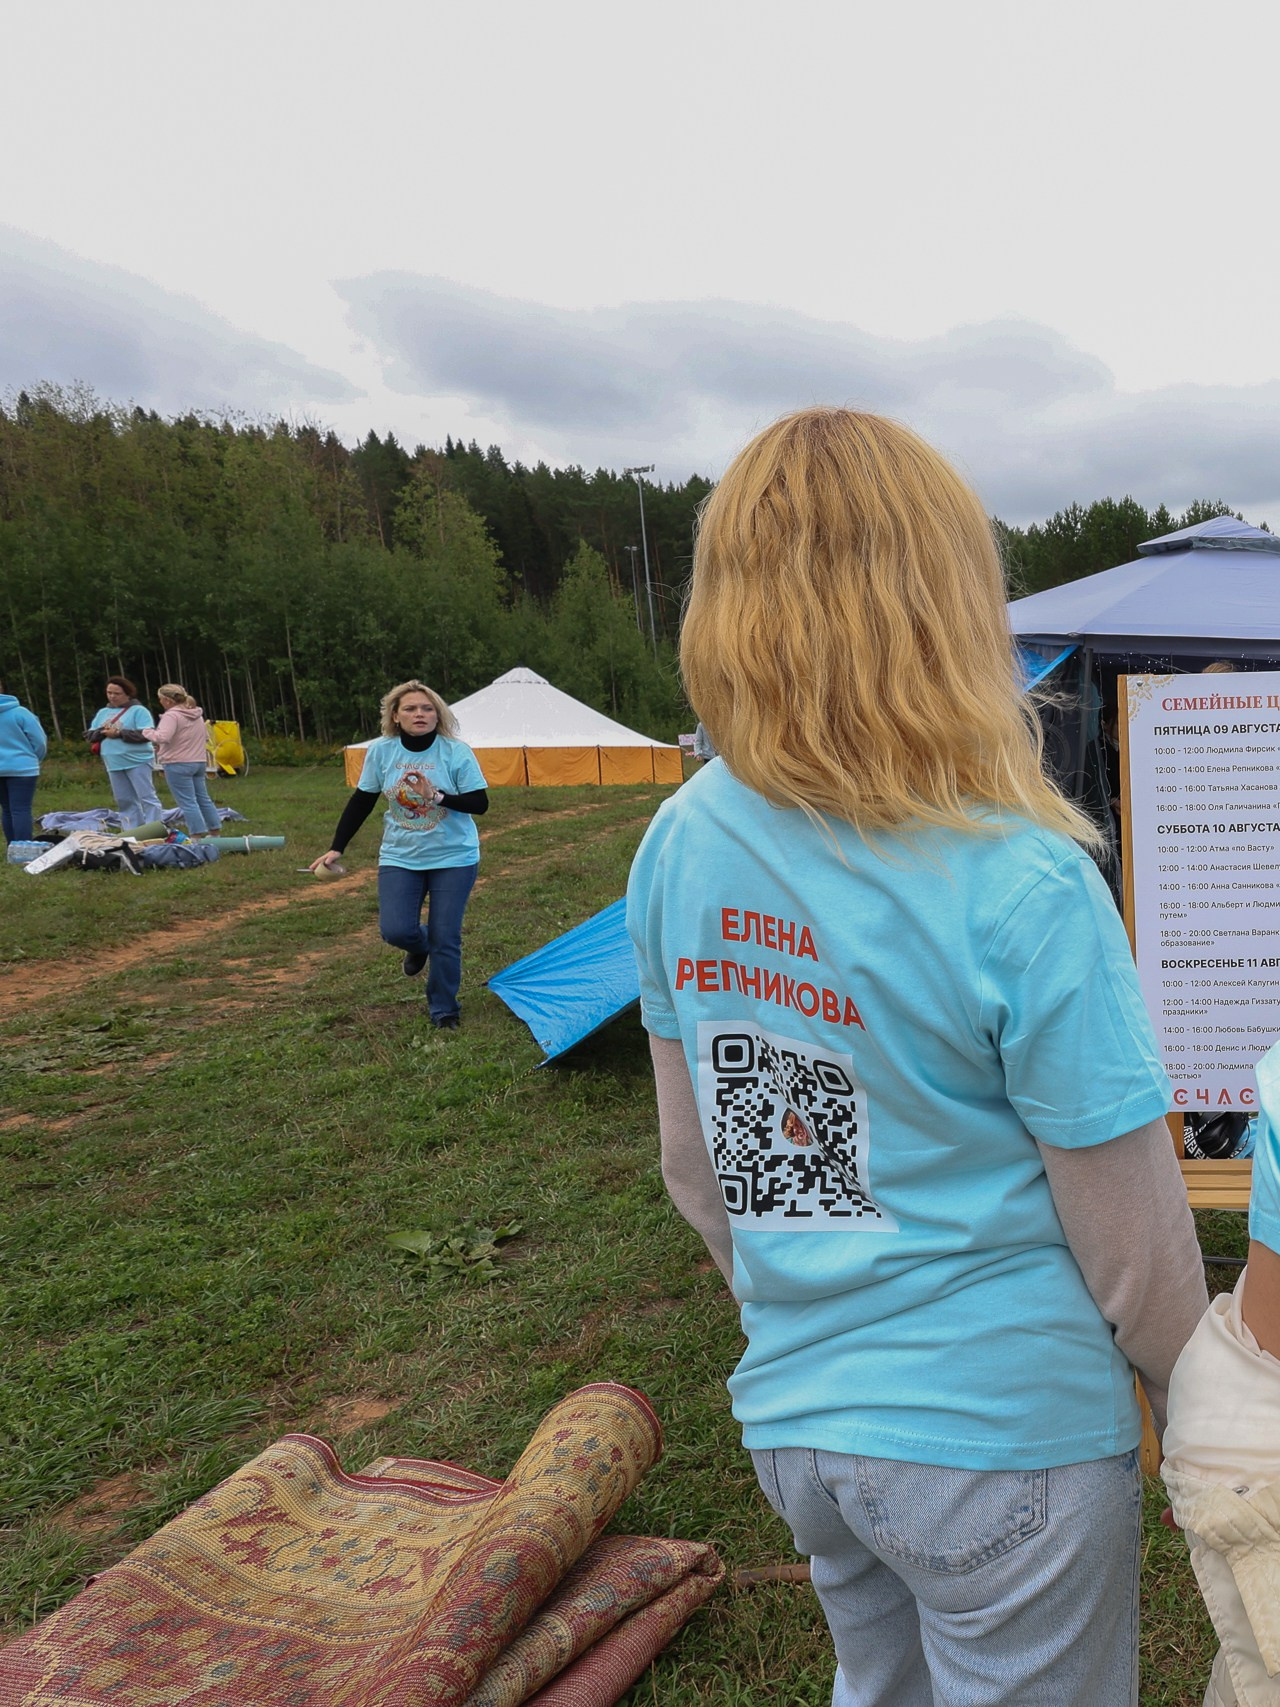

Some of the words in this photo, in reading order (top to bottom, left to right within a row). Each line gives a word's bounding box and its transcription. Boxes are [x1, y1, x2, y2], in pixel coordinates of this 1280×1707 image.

[1162, 691, 1263, 712] СЕМЕЙНЫЕ
[1154, 725, 1211, 738] ПЯТНИЦА
[1213, 724, 1229, 735] 09
[1154, 747, 1176, 755] 10:00
[1183, 746, 1205, 755] 12:00
[1206, 746, 1244, 755] Людмила
[1245, 745, 1276, 754] Фирсик
[1155, 766, 1177, 774] 12:00
[1184, 765, 1205, 774] 14:00
[1207, 765, 1231, 773] Елена
[1232, 764, 1274, 773] Репникова
[1156, 785, 1177, 793] 14:00
[1185, 784, 1206, 793] 16:00
[1207, 784, 1239, 792] Татьяна
[1241, 783, 1278, 791] Хасанова
[1156, 804, 1178, 812] 16:00
[1185, 803, 1207, 812] 18:00
[1208, 803, 1224, 811] Оля
[1225, 802, 1271, 811] Галичанина
[1157, 824, 1210, 834] СУББОТА
[1212, 824, 1226, 833] 10
[1157, 845, 1179, 854] 10:00
[1186, 845, 1208, 853] 12:00
[1158, 864, 1180, 872] 12:00
[1187, 864, 1209, 872] 14:00
[1210, 863, 1252, 871] Анастасия
[1159, 883, 1181, 891] 14:00
[1188, 882, 1209, 891] 16:00
[1210, 882, 1230, 890] Анна
[1231, 882, 1274, 890] Санникова
[1160, 902, 1181, 910] 16:00
[1188, 901, 1210, 909] 18:00
[1211, 901, 1244, 910] Альберт
[721, 907, 819, 962] ЕЛЕНА
[1160, 930, 1182, 938] 18:00
[1188, 929, 1212, 937] 20:00
[1212, 929, 1250, 937] Светлана
[1161, 959, 1245, 969] ВОСКРЕСЕНЬЕ
[1247, 958, 1257, 968] 11
[1162, 980, 1183, 988] 10:00
[1190, 979, 1212, 988] 12:00
[1213, 979, 1246, 987] Алексей
[1247, 979, 1280, 988] Калугин
[675, 957, 867, 1032] РЕПНИКОВА
[1163, 998, 1184, 1006] 12:00
[1191, 998, 1213, 1006] 14:00
[1214, 998, 1250, 1007] Надежда
[1163, 1026, 1185, 1034] 14:00
[1192, 1026, 1214, 1034] 16:00
[1215, 1026, 1246, 1034] Любовь
[1192, 1044, 1214, 1052] 18:00
[1215, 1044, 1240, 1053] Денис
[1165, 1063, 1186, 1071] 18:00
[1193, 1063, 1215, 1071] 20:00
[1216, 1062, 1254, 1071] Людмила
[1167, 1073, 1202, 1081] частью»
